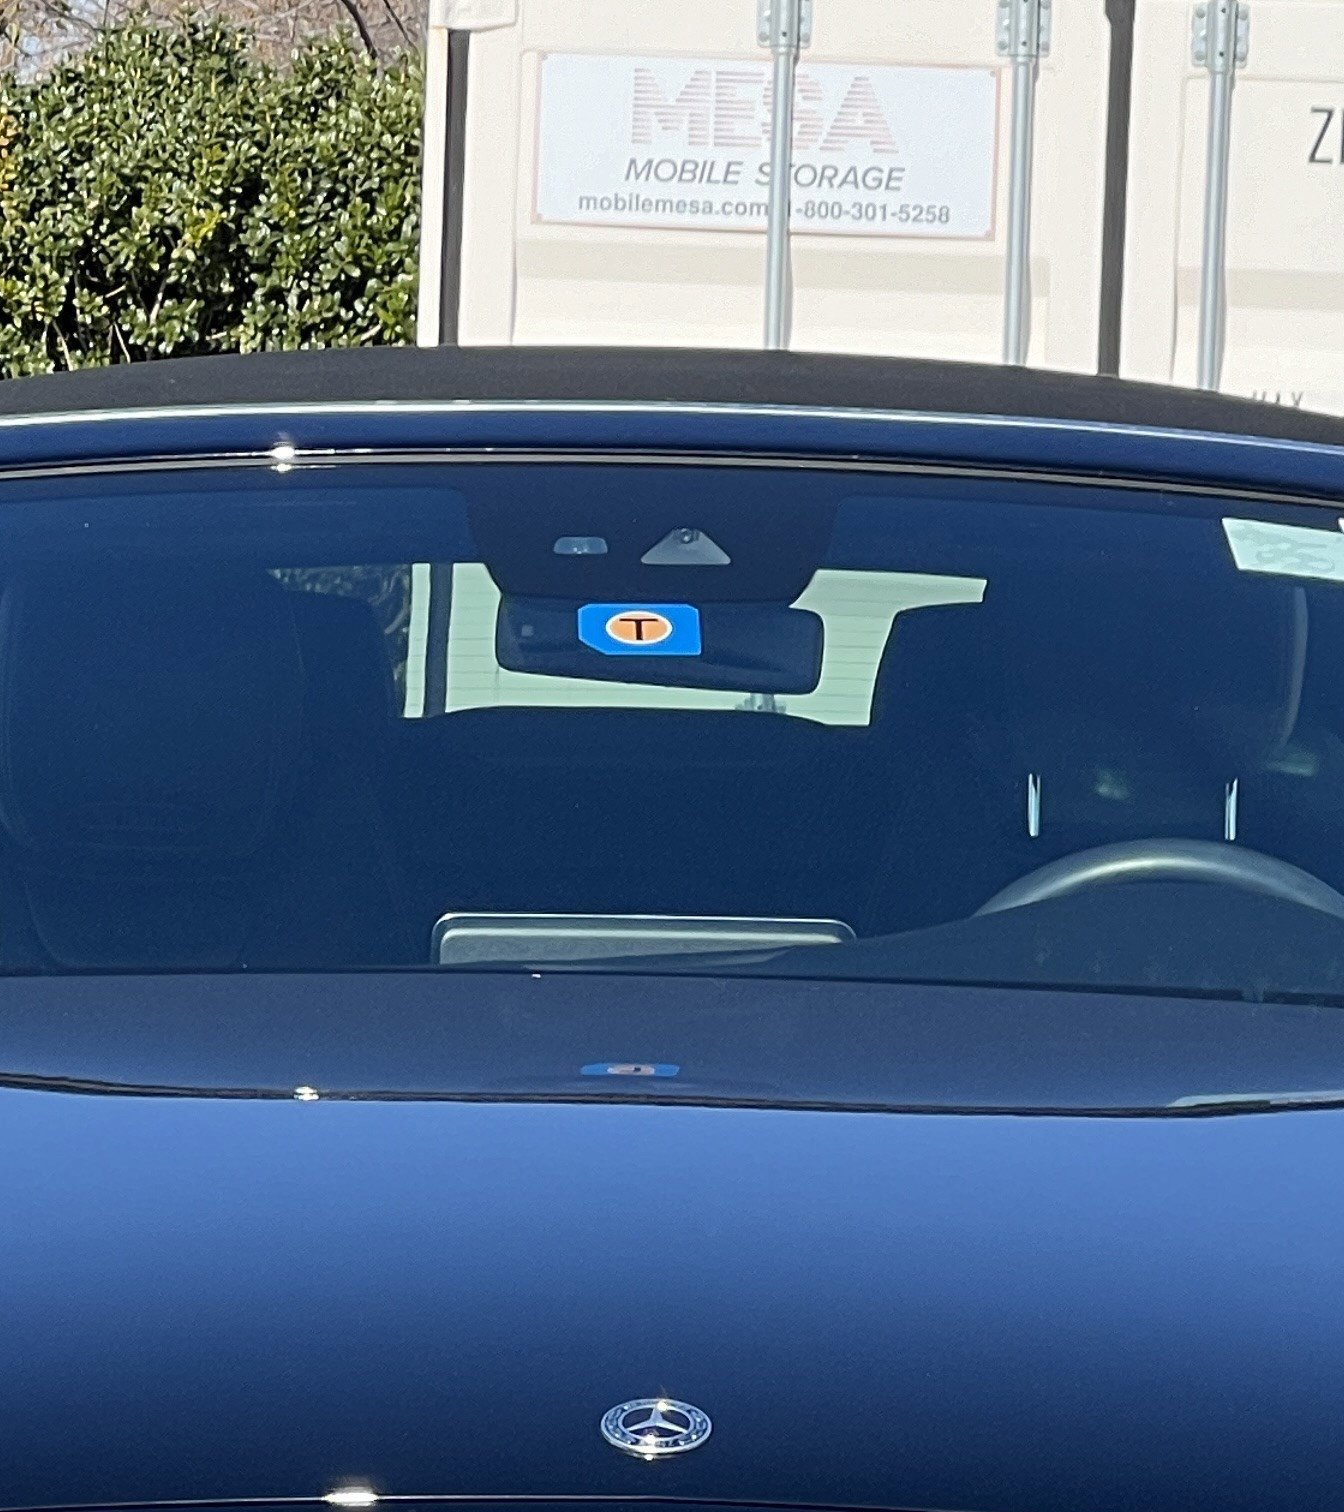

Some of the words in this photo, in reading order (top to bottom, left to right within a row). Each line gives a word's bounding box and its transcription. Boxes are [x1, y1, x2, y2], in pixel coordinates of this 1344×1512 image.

[631, 67, 899, 154] MESA
[624, 157, 744, 185] MOBILE
[755, 160, 906, 192] SORAGE
[577, 192, 769, 217] mobilemesa.com
[619, 617, 658, 641] T
